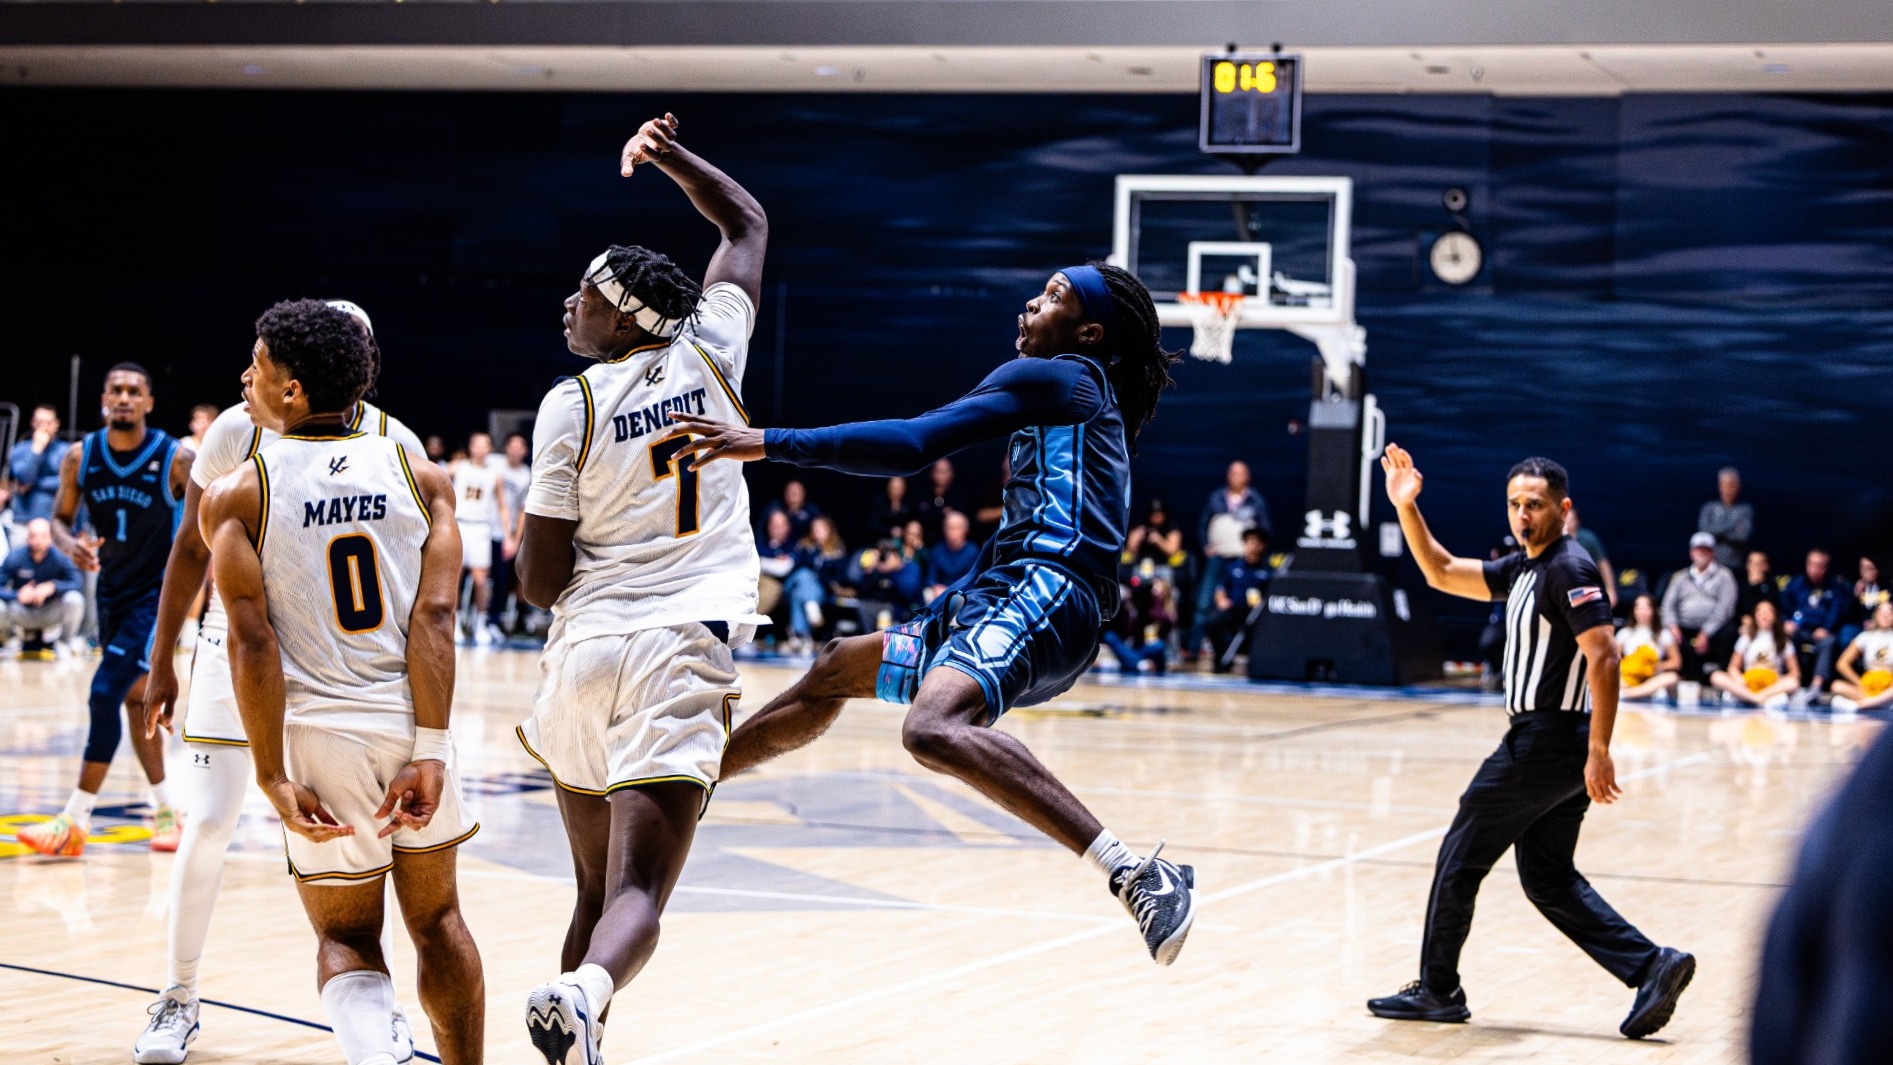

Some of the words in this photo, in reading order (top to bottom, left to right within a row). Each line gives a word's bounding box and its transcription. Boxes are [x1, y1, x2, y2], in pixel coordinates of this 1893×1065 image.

[612, 387, 707, 443] DENGDIT
[91, 486, 116, 504] SAN
[118, 485, 153, 509] DIEGO
[647, 432, 702, 539] 7
[116, 508, 127, 542] 1
[303, 494, 387, 528] MAYES
[325, 531, 386, 635] 0
